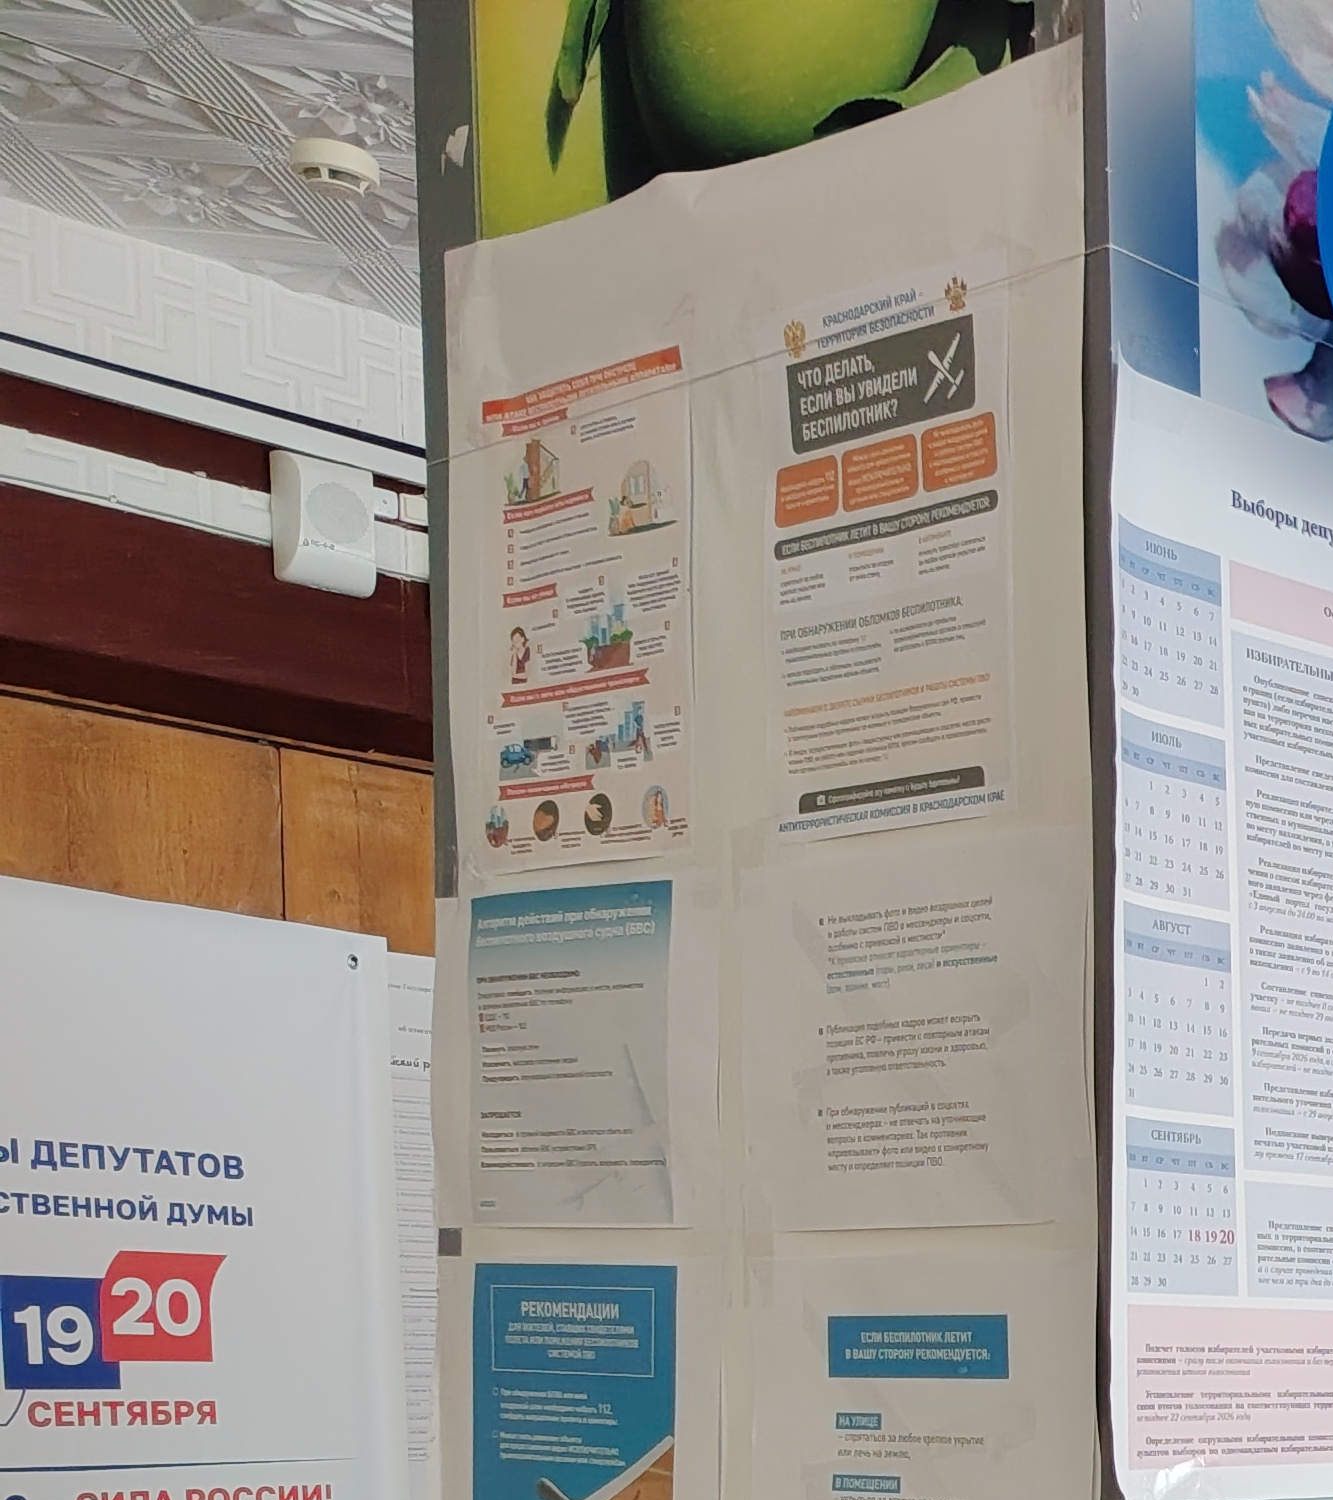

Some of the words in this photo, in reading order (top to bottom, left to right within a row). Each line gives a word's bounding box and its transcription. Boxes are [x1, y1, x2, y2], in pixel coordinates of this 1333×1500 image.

[822, 295, 892, 328] КРАСНОДАРСКИЙ
[894, 288, 917, 308] КРАЙ
[869, 305, 934, 334] БЕЗОПАСНОСТИ
[798, 367, 822, 390] ЧТО
[824, 354, 875, 387] ДЕЛАТЬ,
[801, 394, 832, 416] ЕСЛИ
[836, 386, 855, 406] ВЫ
[858, 367, 918, 400] УВИДЕЛИ
[802, 399, 898, 442] БЕСПИЛОТНИК?
[1231, 489, 1299, 530] Выборы
[1145, 540, 1177, 561] ИЮНЬ
[1152, 731, 1182, 748] ИЮЛЬ
[1152, 919, 1191, 935] АВГУСТ
[1151, 1130, 1201, 1145] СЕНТЯБРЬ
[31, 1140, 245, 1180] ДЕПУТАТОВ
[166, 1202, 254, 1227] ДУМЫ
[1173, 1205, 1181, 1215] 10
[1190, 1207, 1198, 1216] 11
[1157, 1229, 1166, 1238] 16
[1174, 1230, 1181, 1239] 17
[1188, 1230, 1201, 1242] 18
[1205, 1231, 1217, 1243] 19
[1220, 1230, 1234, 1244] 20
[1174, 1254, 1183, 1264] 24
[521, 1300, 619, 1321] РЕКОМЕНДАЦИИ
[13, 1305, 93, 1366] 19
[111, 1277, 201, 1337] 20
[861, 1332, 882, 1343] ЕСЛИ
[884, 1332, 943, 1343] БЕСПИЛОТНИК
[944, 1332, 972, 1343] ЛЕТИТ
[853, 1349, 876, 1360] ВАШУ
[878, 1349, 914, 1360] СТОРОНУ
[28, 1401, 217, 1427] СЕНТЯБРЯ
[838, 1415, 850, 1427] НА
[852, 1416, 879, 1427] УЛИЦЕ
[843, 1478, 897, 1491] ПОМЕЩЕНИИ
